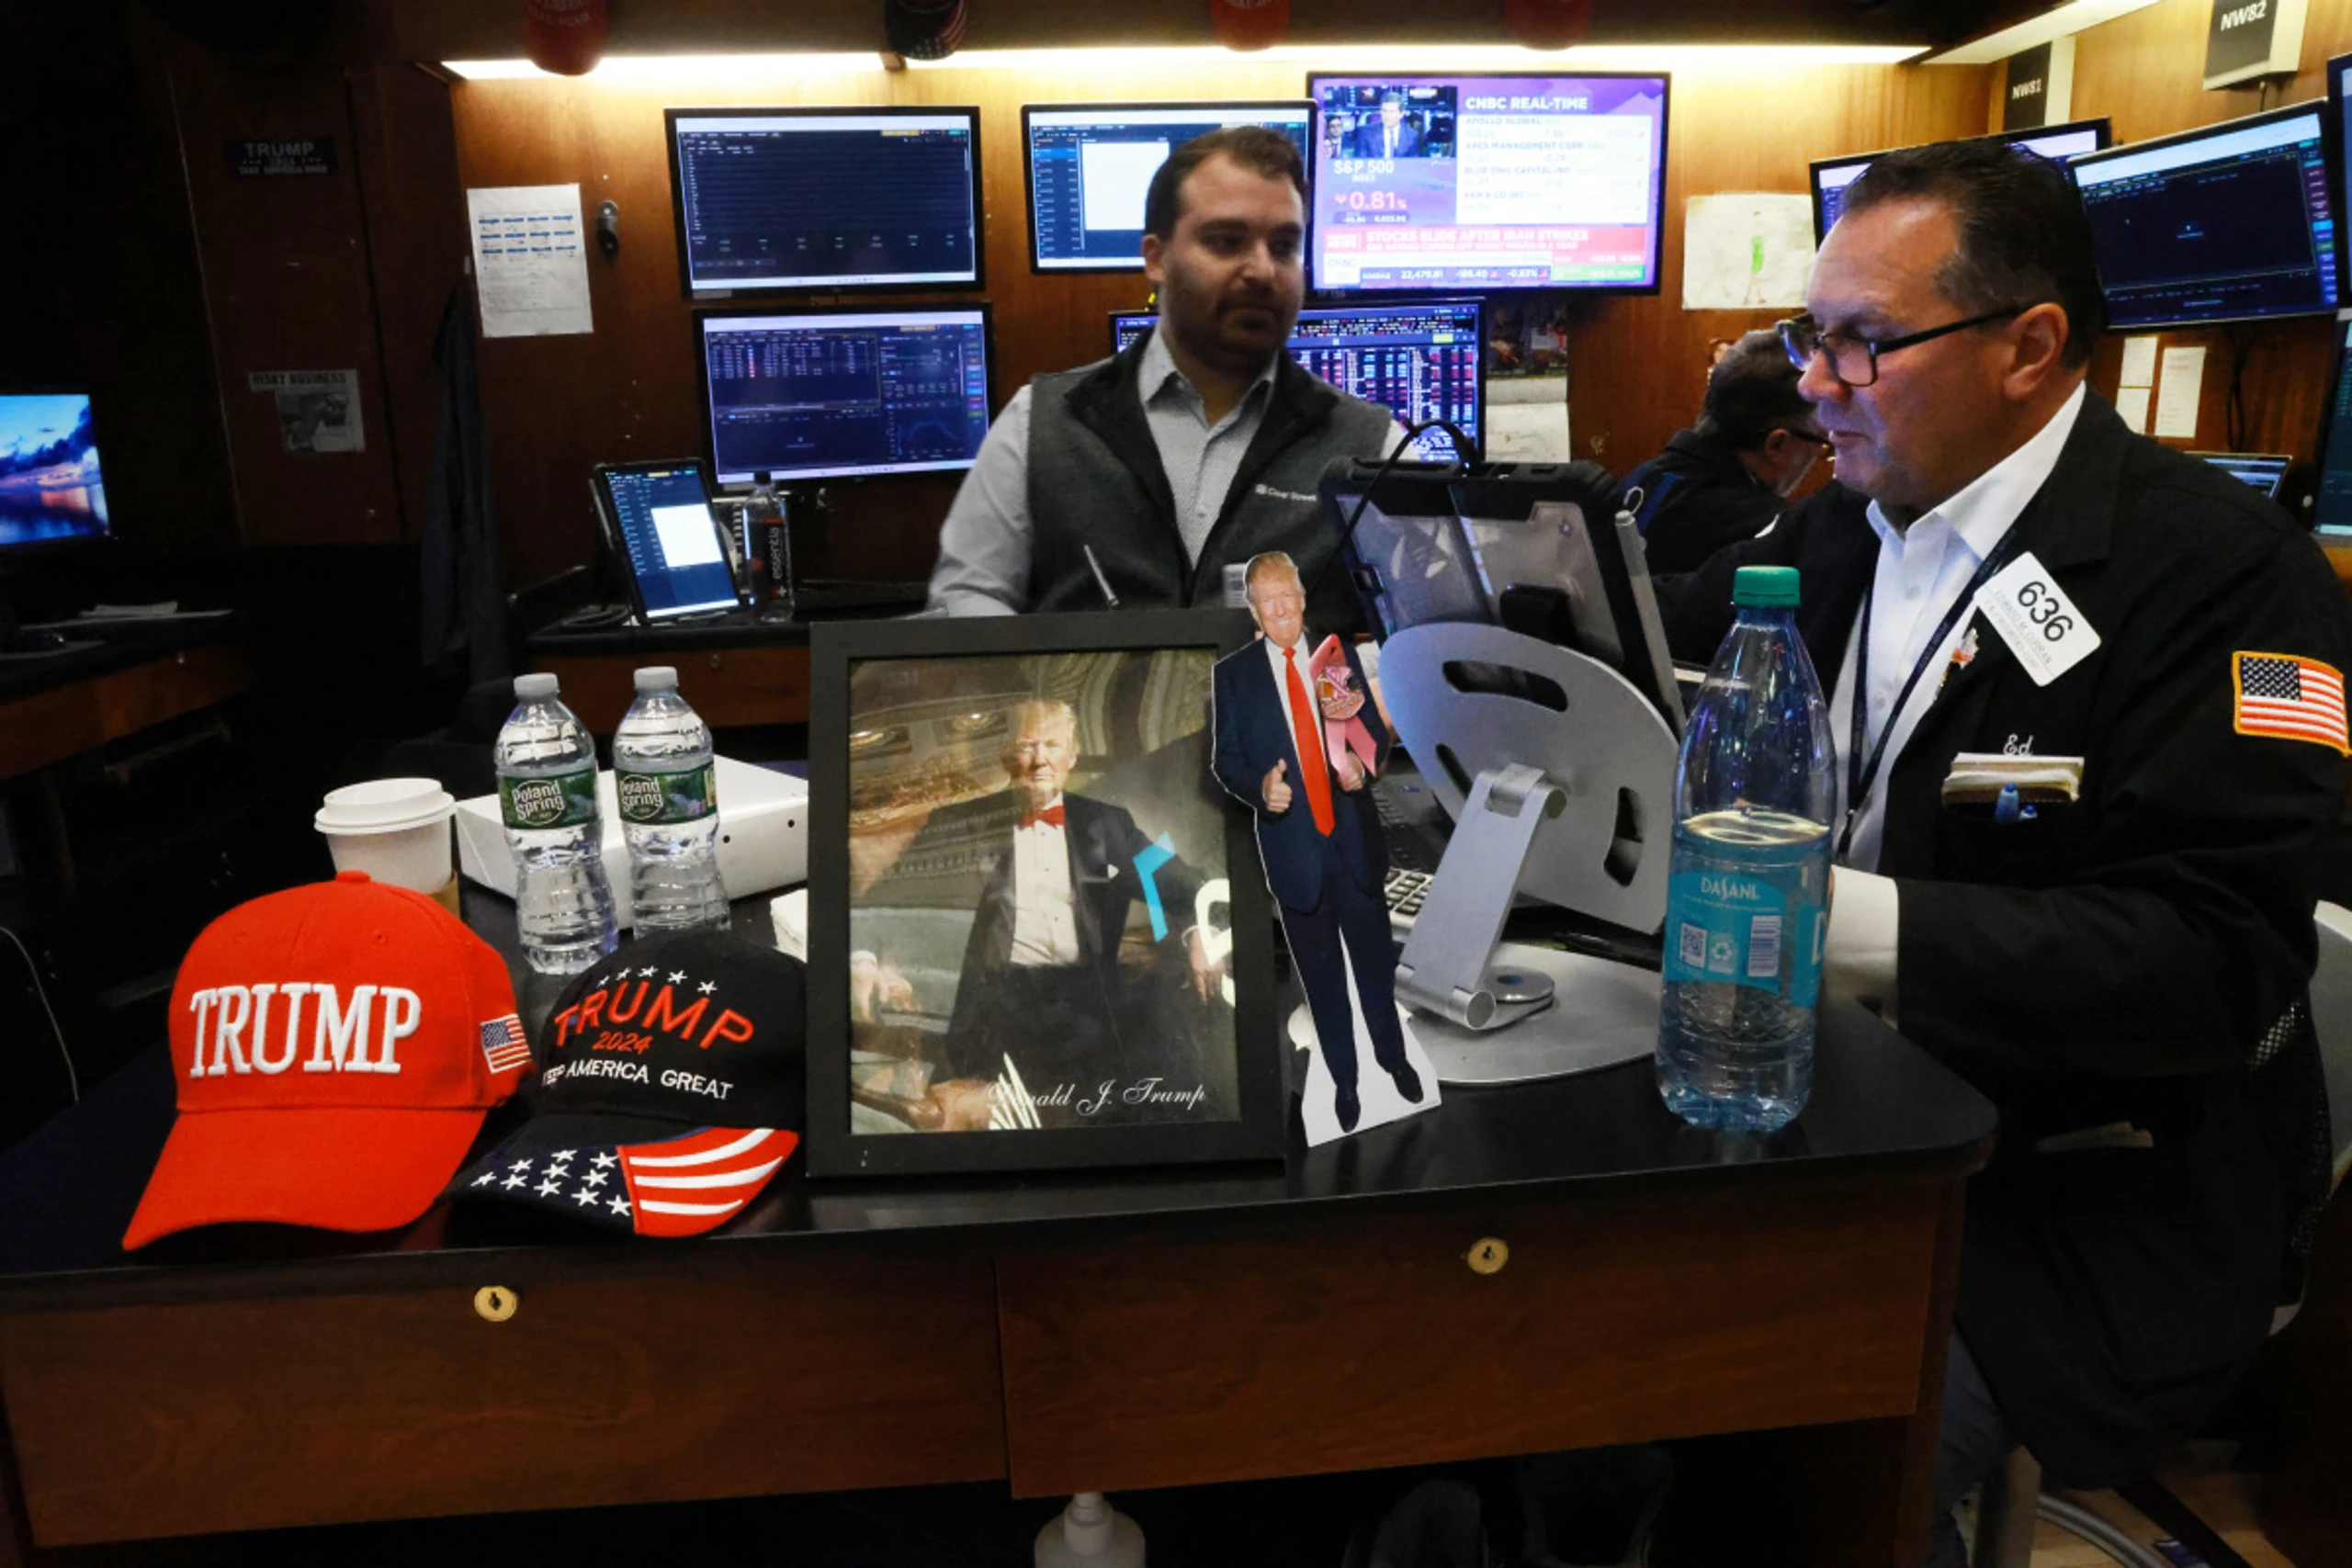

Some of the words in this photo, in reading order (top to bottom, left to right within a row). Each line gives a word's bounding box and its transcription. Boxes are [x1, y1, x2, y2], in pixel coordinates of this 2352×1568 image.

[2220, 1, 2267, 31] NW82
[2012, 78, 2042, 99] NW81
[1464, 96, 1507, 110] CNBC
[1510, 96, 1589, 110] REAL-TIME
[243, 141, 315, 157] TRUMP
[1333, 160, 1364, 175] S&P
[1367, 160, 1395, 174] 500
[1366, 231, 1417, 243] STOCKS
[1419, 231, 1456, 242] SLIDE
[1459, 231, 1501, 242] AFTER
[1537, 230, 1589, 242] STRIKES
[252, 374, 286, 386] RISKY
[289, 372, 346, 385] BUSINESS
[768, 525, 784, 580] essentia
[2017, 580, 2074, 643] 636
[2003, 734, 2034, 757] Ed
[511, 779, 562, 806] Poland
[620, 776, 661, 798] Poland
[515, 795, 566, 821] Spring
[621, 793, 664, 812] Spring
[1701, 875, 1758, 901] DASANI
[554, 981, 755, 1050] TRUMP
[189, 982, 421, 1077] TRUMP
[592, 1030, 653, 1055] 2024
[566, 1059, 650, 1085] AMERICA
[661, 1069, 734, 1100] GREAT
[987, 1082, 1076, 1108] ald
[1123, 1077, 1206, 1111] Trump
